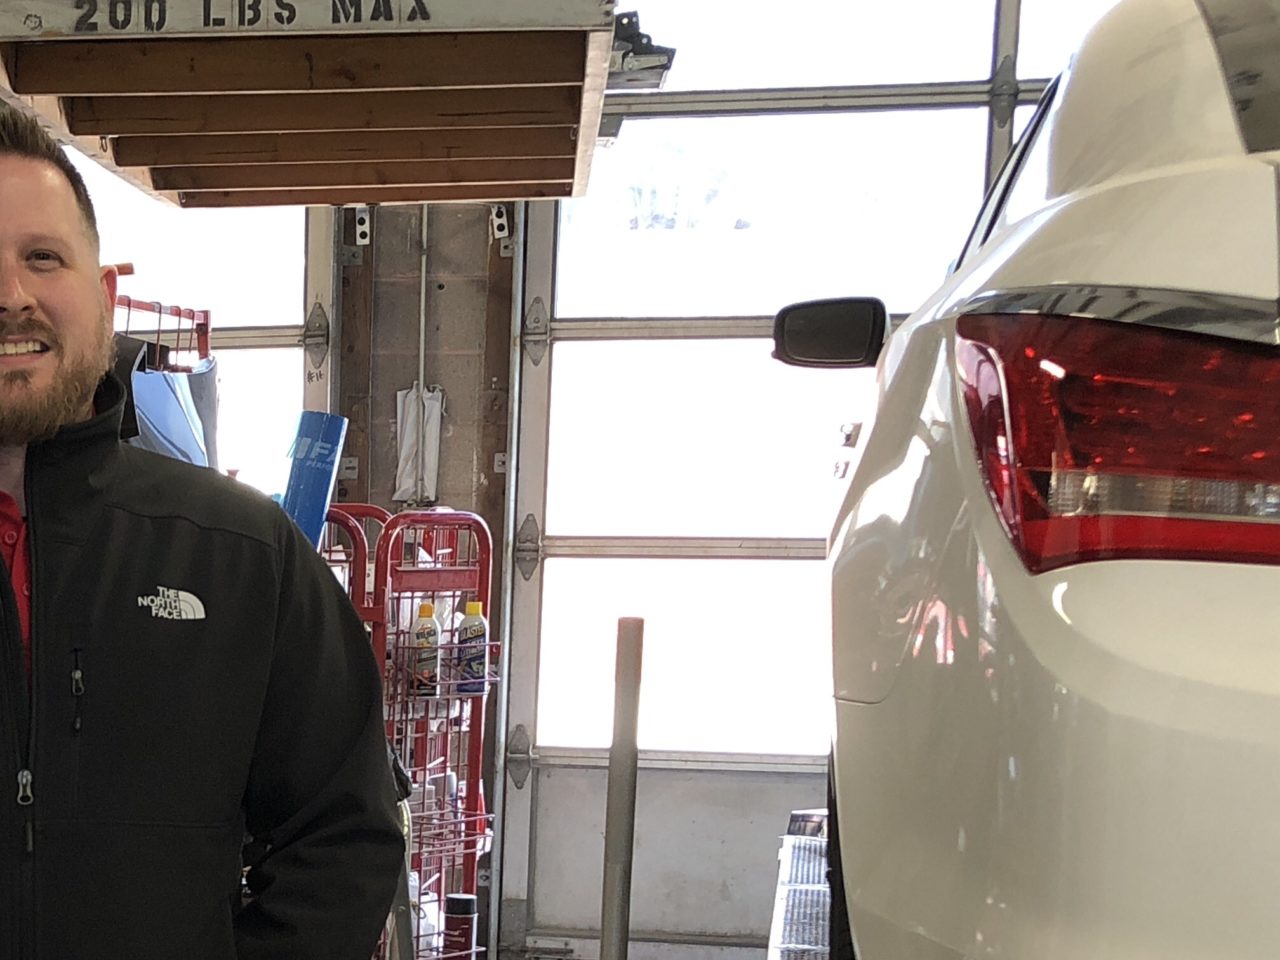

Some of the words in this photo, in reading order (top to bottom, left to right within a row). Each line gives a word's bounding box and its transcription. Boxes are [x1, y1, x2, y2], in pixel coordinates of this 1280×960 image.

[74, 0, 167, 32] 200
[203, 0, 296, 27] LBS
[332, 0, 431, 24] MAX
[157, 585, 179, 598] THE
[137, 595, 180, 611] NORTH
[152, 606, 182, 619] FACE
